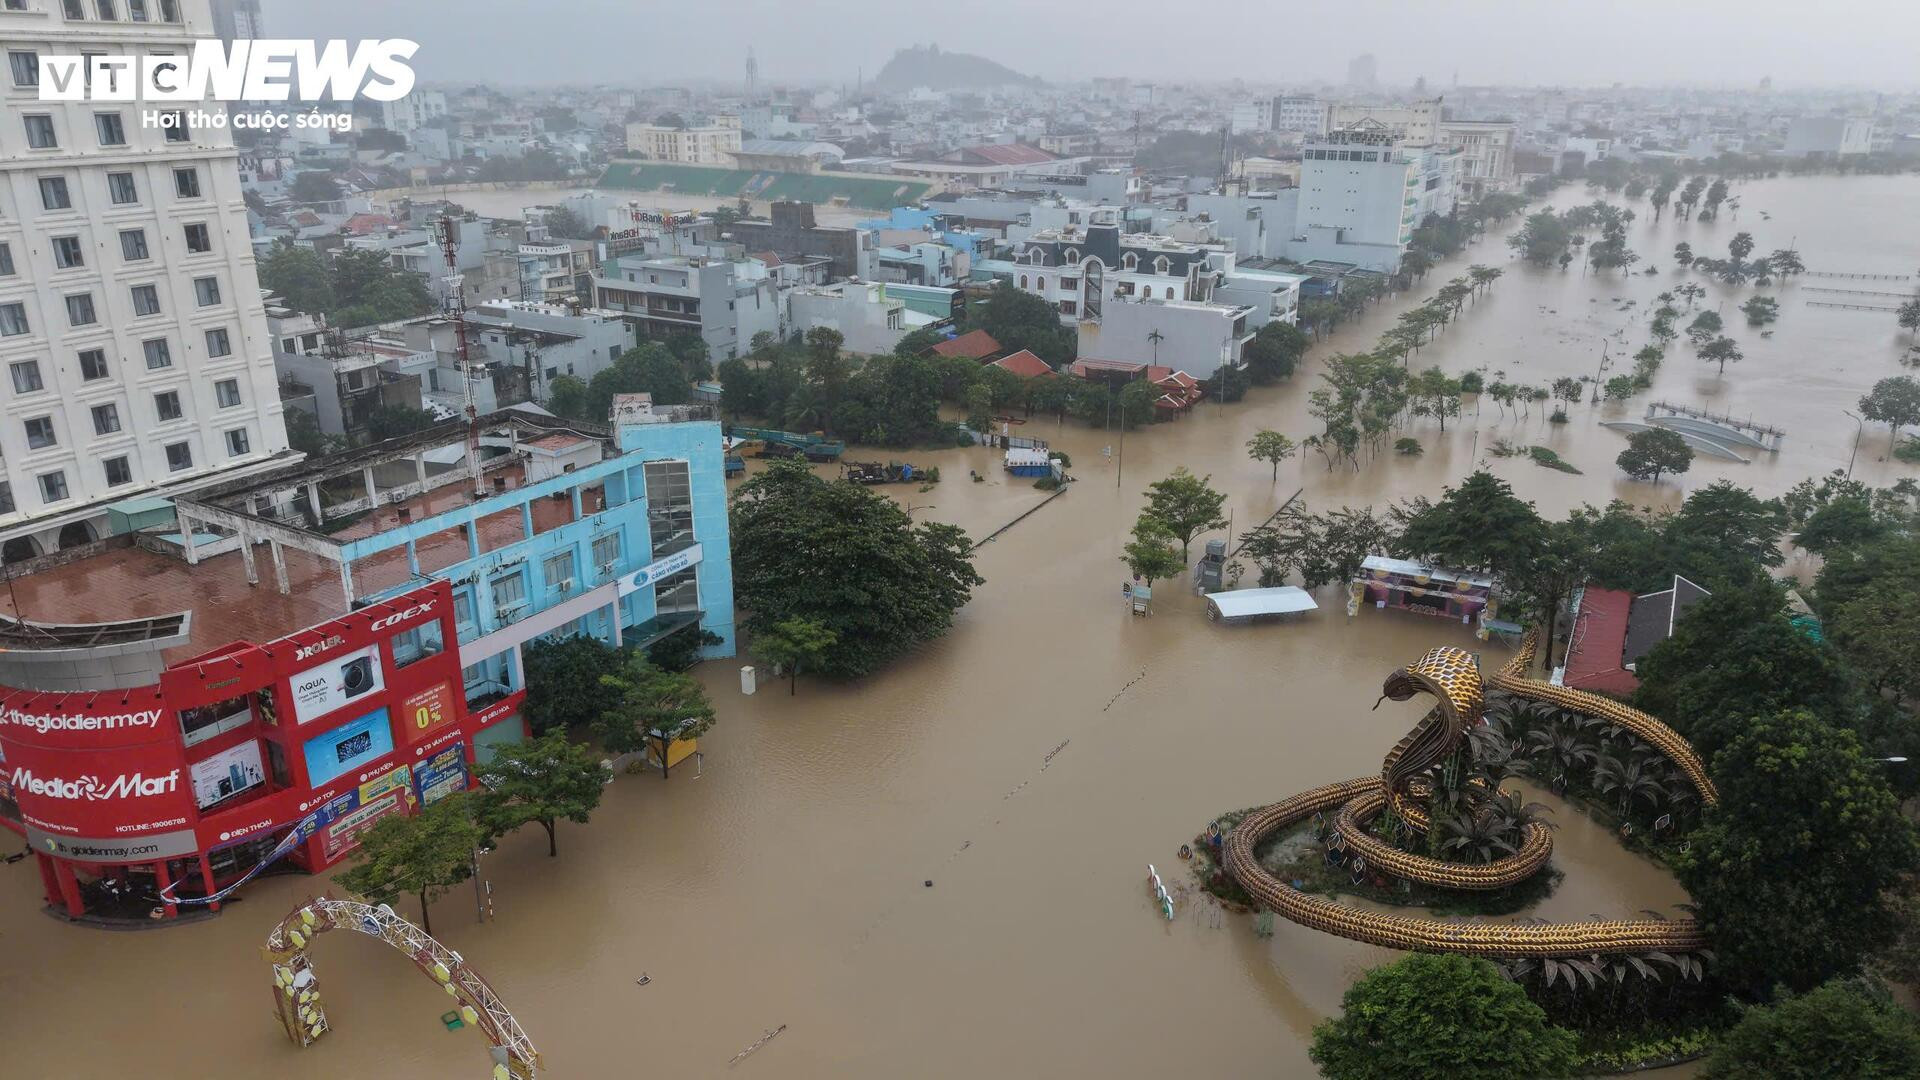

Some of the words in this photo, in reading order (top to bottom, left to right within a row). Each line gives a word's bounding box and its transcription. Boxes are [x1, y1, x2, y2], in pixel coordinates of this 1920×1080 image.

[631, 211, 663, 225] HDBank
[371, 599, 437, 632] COEX
[298, 677, 327, 694] AQUA
[10, 709, 162, 734] thegioidienmay
[308, 796, 321, 808] LAP
[323, 790, 335, 800] TOP
